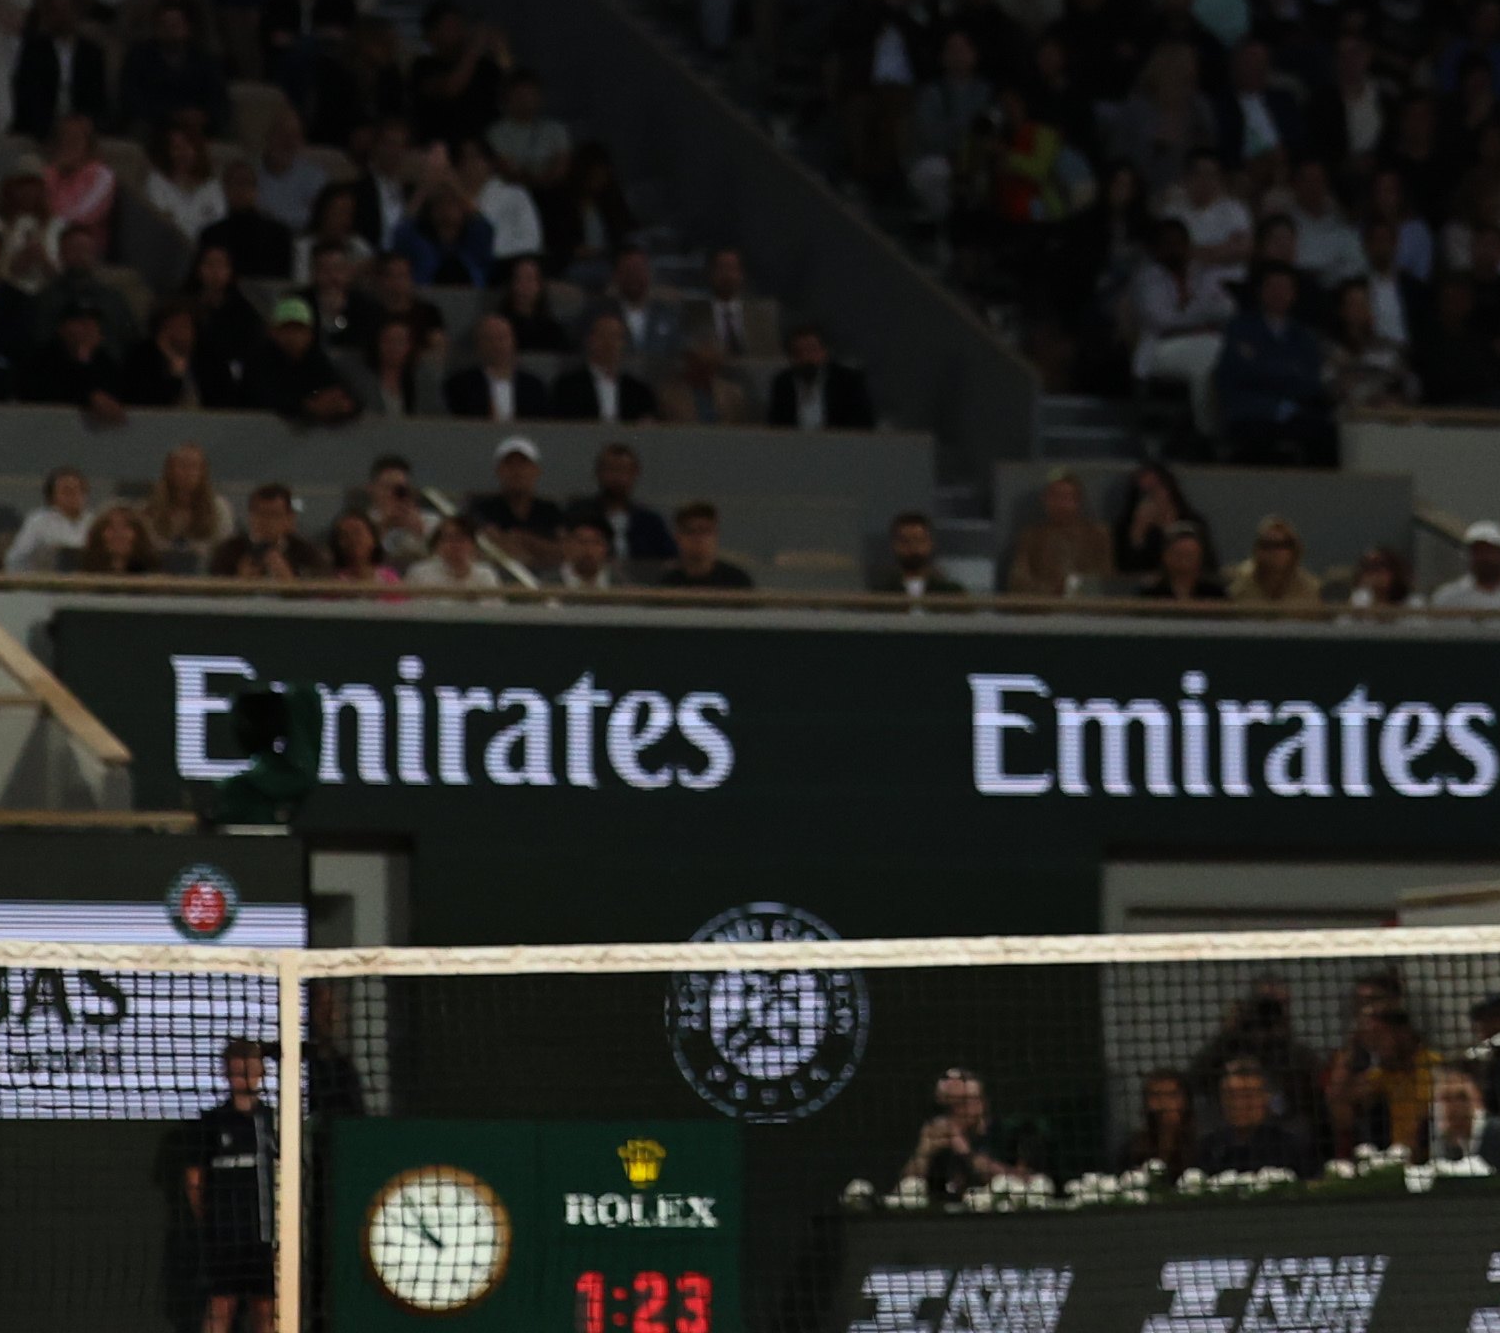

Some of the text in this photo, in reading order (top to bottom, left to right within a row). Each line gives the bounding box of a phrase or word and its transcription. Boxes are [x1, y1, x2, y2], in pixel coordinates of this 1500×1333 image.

[170, 654, 735, 789] Emirates
[967, 670, 1500, 798] Emirates
[564, 1192, 719, 1228] ROLEX
[575, 1270, 714, 1333] 1:23
